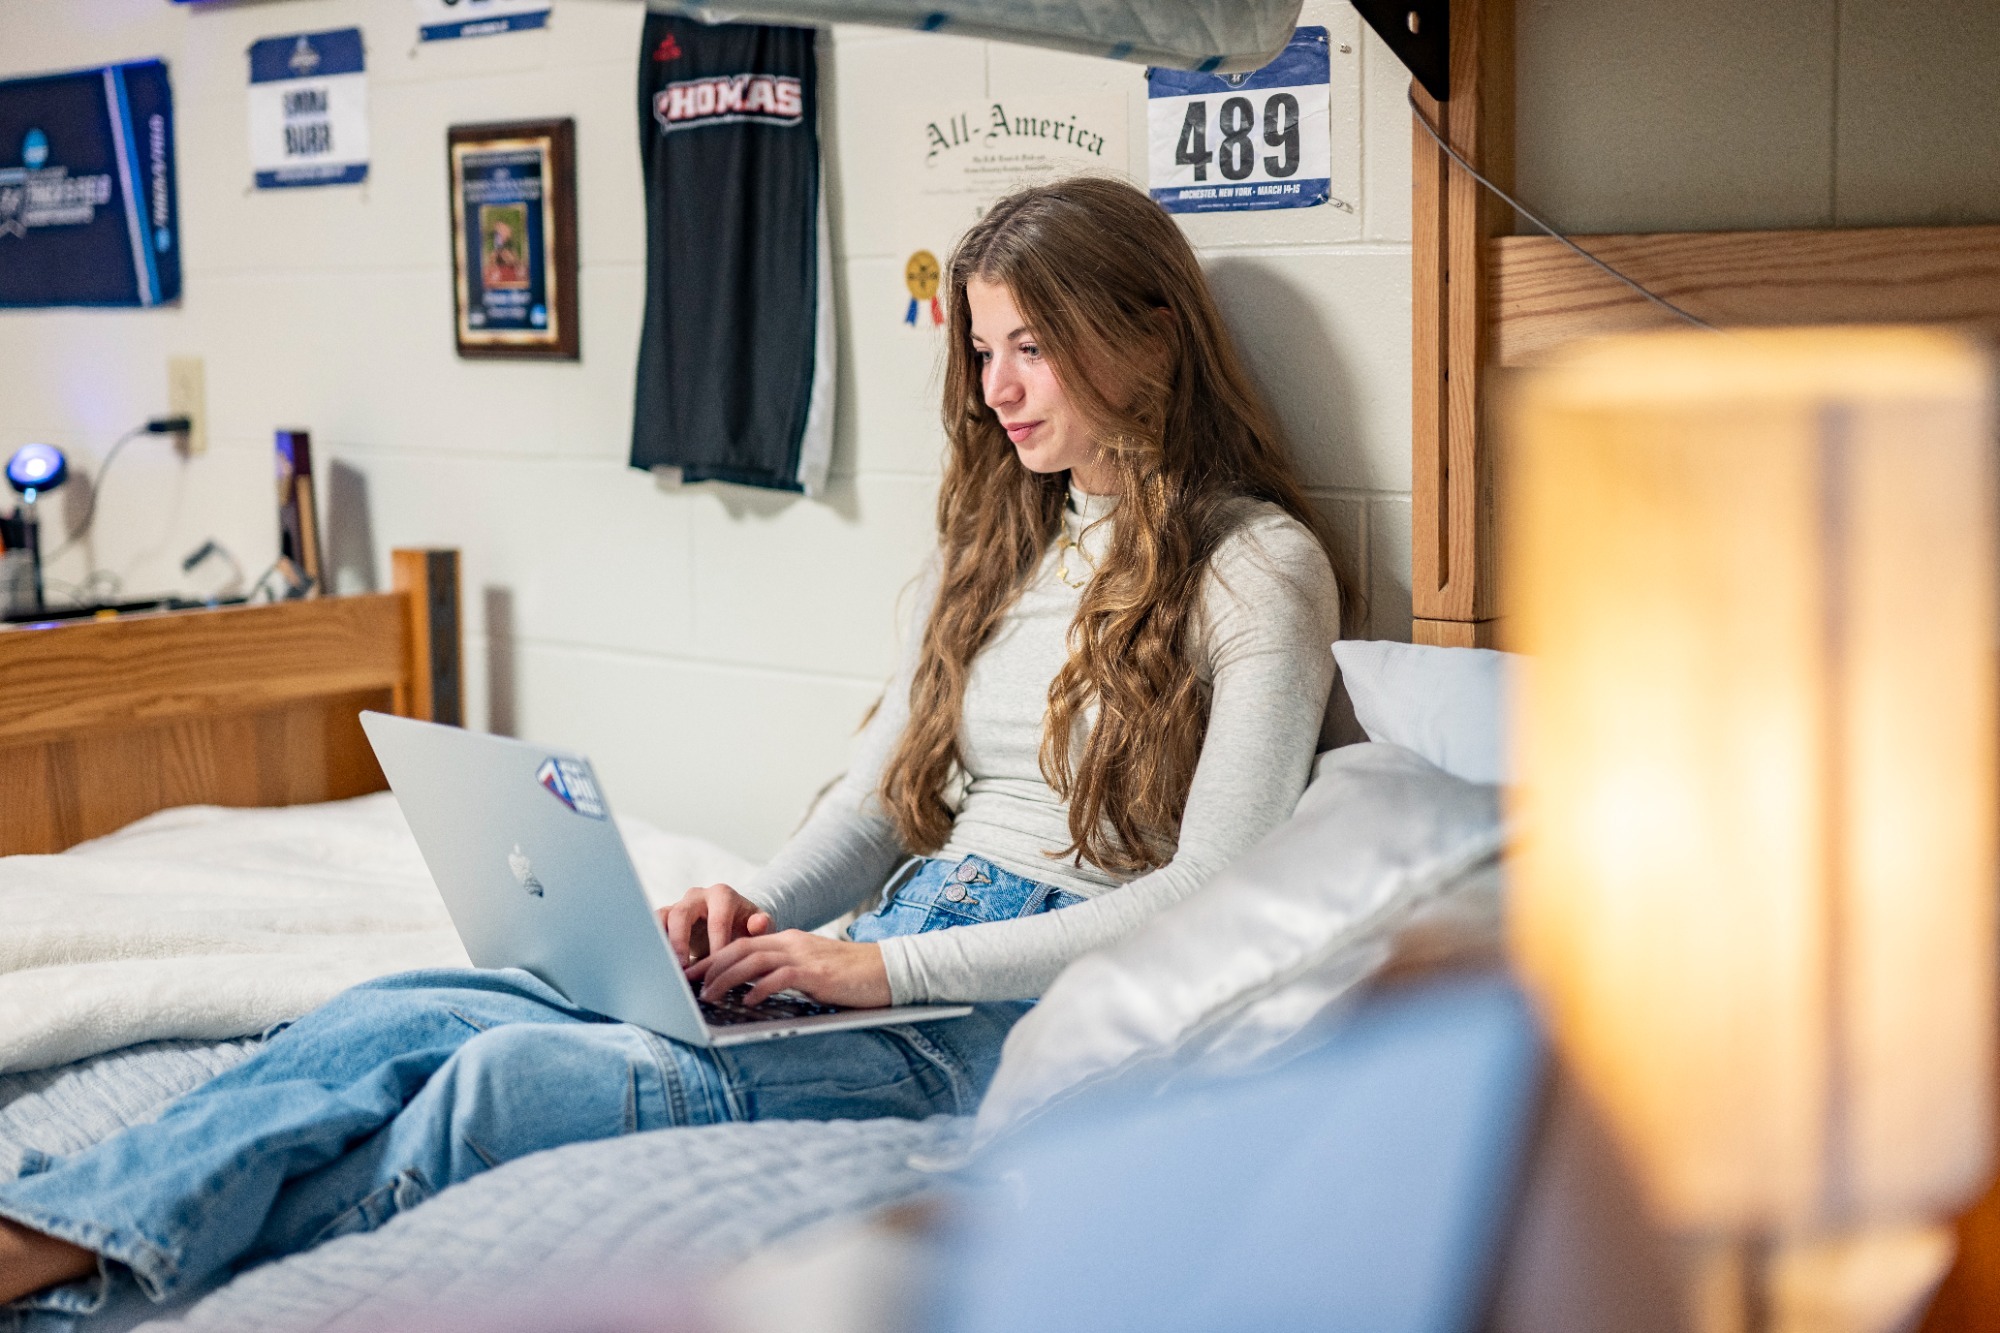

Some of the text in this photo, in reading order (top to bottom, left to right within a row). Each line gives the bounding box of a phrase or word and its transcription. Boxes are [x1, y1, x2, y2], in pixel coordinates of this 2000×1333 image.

[926, 103, 1106, 167] All-America
[1175, 93, 1300, 182] 489
[1178, 187, 1218, 200] ROCHESTER,
[1218, 187, 1234, 198] NEW
[1234, 185, 1252, 197] YORK
[1257, 183, 1282, 196] MARCH
